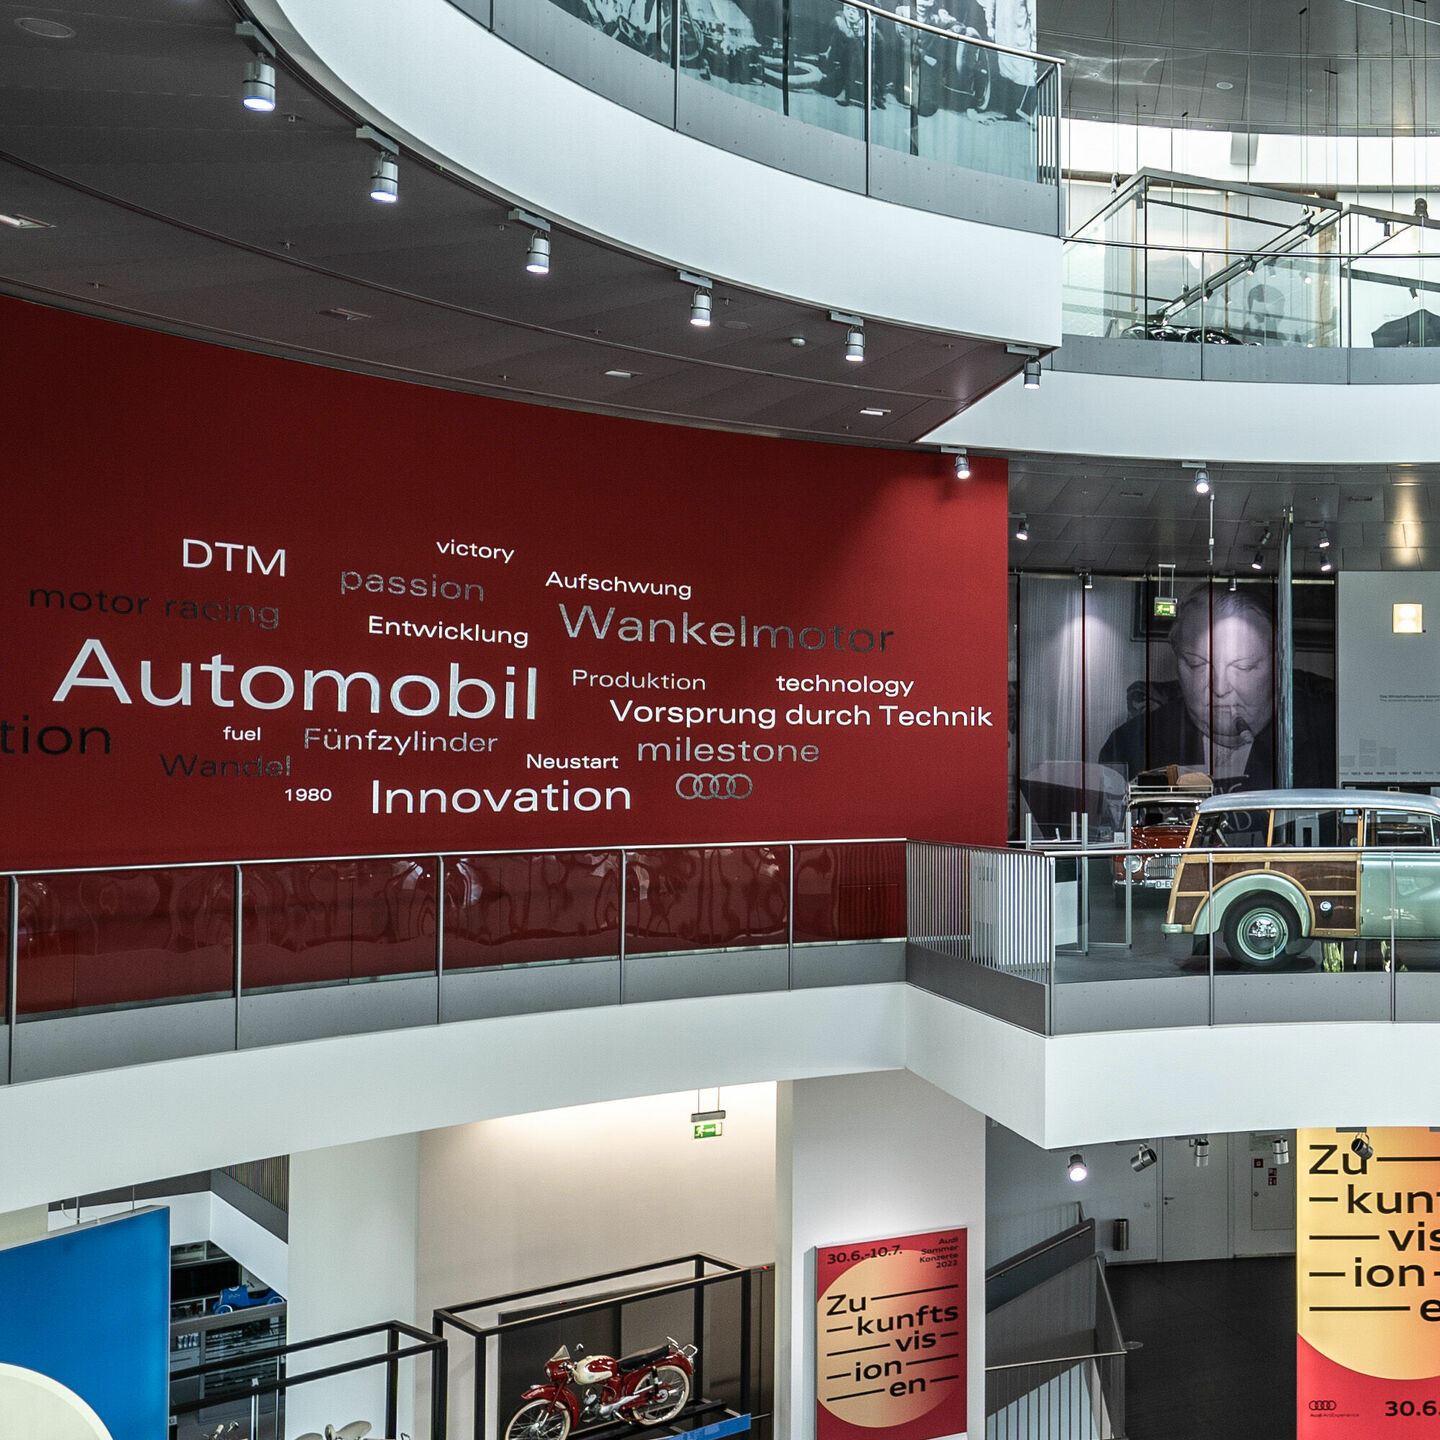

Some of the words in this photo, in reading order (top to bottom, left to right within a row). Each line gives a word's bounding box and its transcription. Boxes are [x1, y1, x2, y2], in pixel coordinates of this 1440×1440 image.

[182, 538, 287, 577] DTM
[436, 539, 515, 564] victory
[340, 570, 485, 603] passion
[545, 571, 692, 600] Aufschwung
[29, 587, 151, 615] motor
[164, 596, 280, 630] racing
[368, 615, 529, 649] Entwicklung
[558, 602, 895, 653] Wankelmotor
[52, 637, 537, 721] Automobil
[572, 669, 706, 691] Produktion
[776, 674, 914, 697] technology
[609, 699, 777, 730] Vorsprung
[785, 703, 871, 727] durch
[878, 704, 993, 728] Technik
[0, 714, 112, 756] tion
[222, 726, 262, 742] fuel
[303, 727, 499, 757] Fünfzylinder
[526, 753, 619, 770] Neustart
[637, 736, 820, 762] milestone
[160, 753, 292, 778] Wandel
[284, 787, 333, 803] 1980
[372, 779, 632, 814] Innovation
[1308, 1144, 1368, 1176] Zu
[826, 1245, 903, 1265] 30.6.-10.7.
[1354, 1257, 1426, 1288] ion
[826, 1294, 867, 1316] Zu
[857, 1304, 959, 1336] kunfts
[895, 1331, 937, 1353] vis
[855, 1360, 903, 1382] ion
[889, 1376, 926, 1398] en
